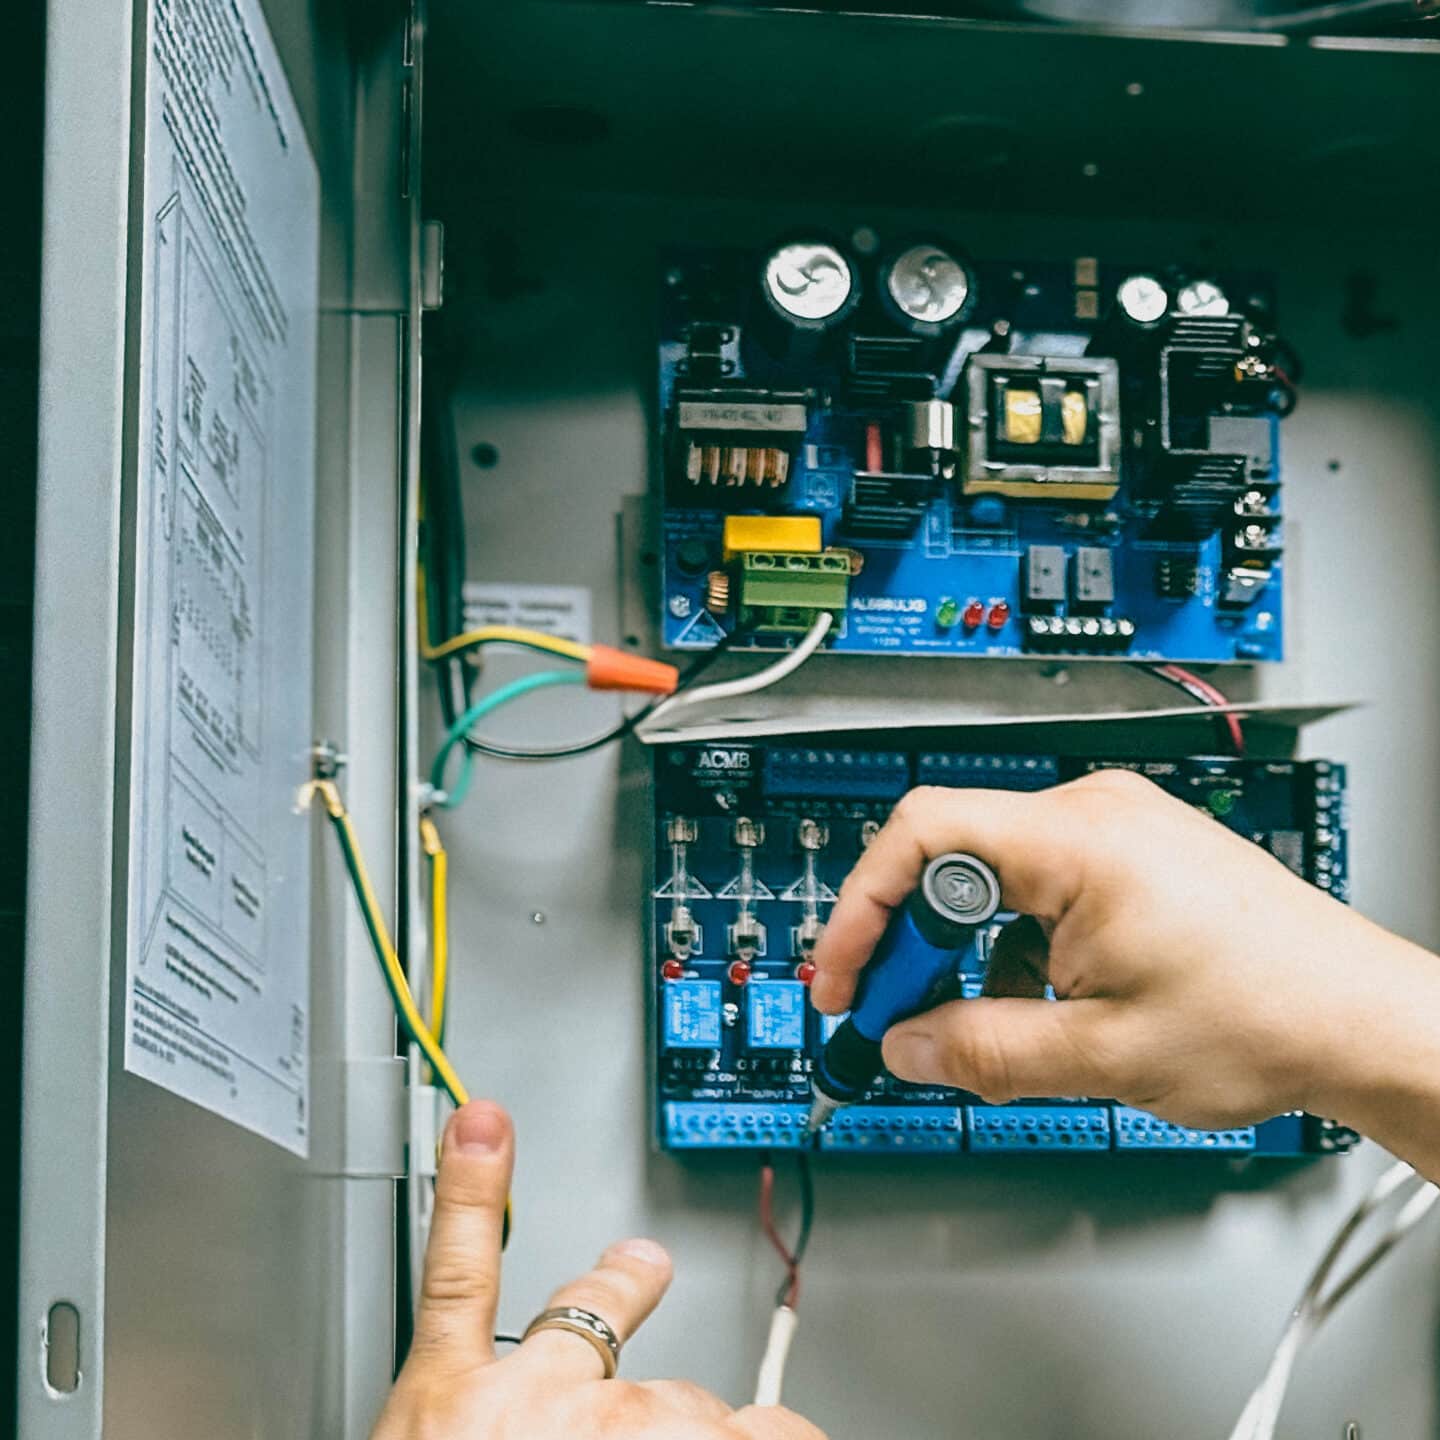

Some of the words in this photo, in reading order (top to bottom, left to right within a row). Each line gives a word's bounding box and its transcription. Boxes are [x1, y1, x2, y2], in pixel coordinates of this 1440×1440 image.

[672, 1057, 720, 1071] RISK
[736, 1058, 760, 1072] OF
[770, 1058, 815, 1073] FIRE
